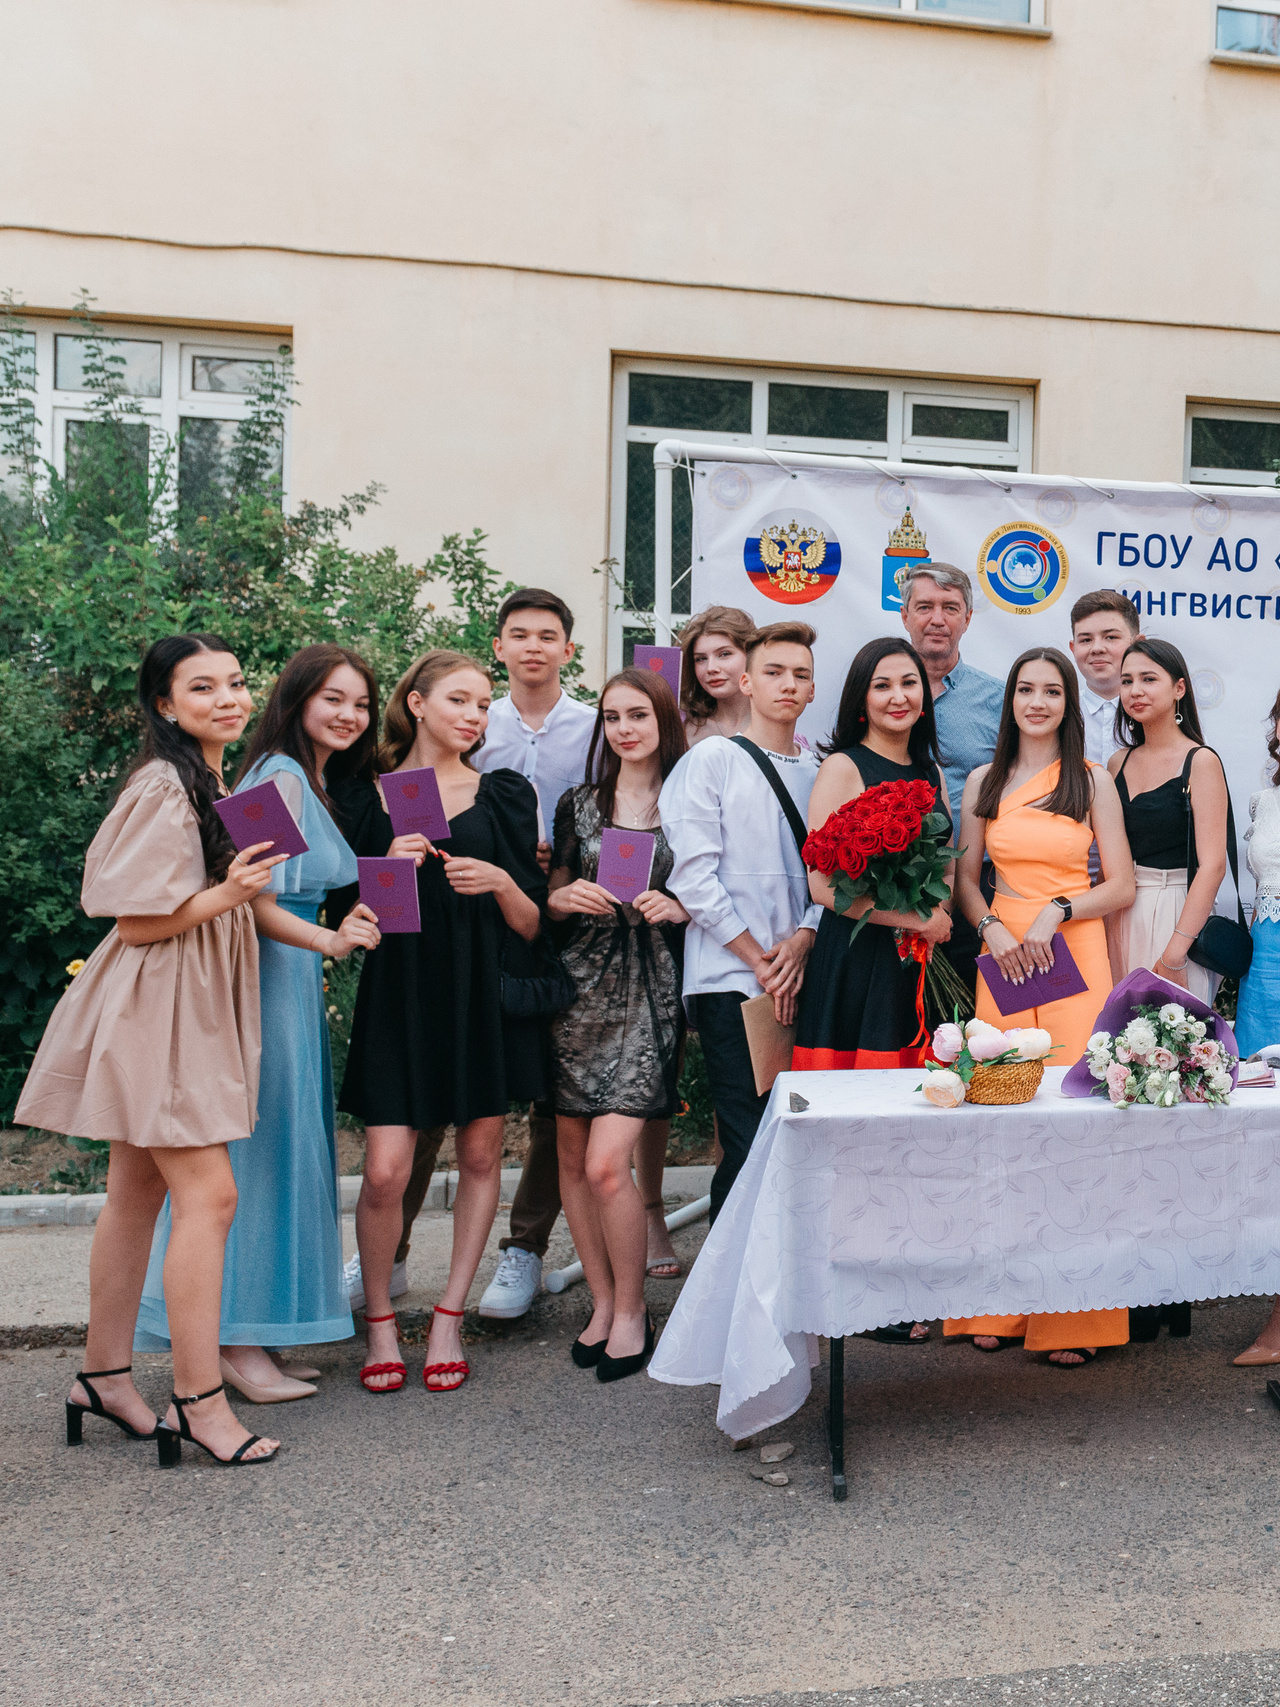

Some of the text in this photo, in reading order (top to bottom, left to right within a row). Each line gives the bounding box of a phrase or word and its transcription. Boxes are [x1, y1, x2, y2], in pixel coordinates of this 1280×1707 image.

[978, 523, 1067, 580] Астраханская Лингвистическая Гимназия
[1096, 531, 1193, 570] ГБОУ
[1206, 537, 1258, 573] АО
[1014, 607, 1032, 615] 1993
